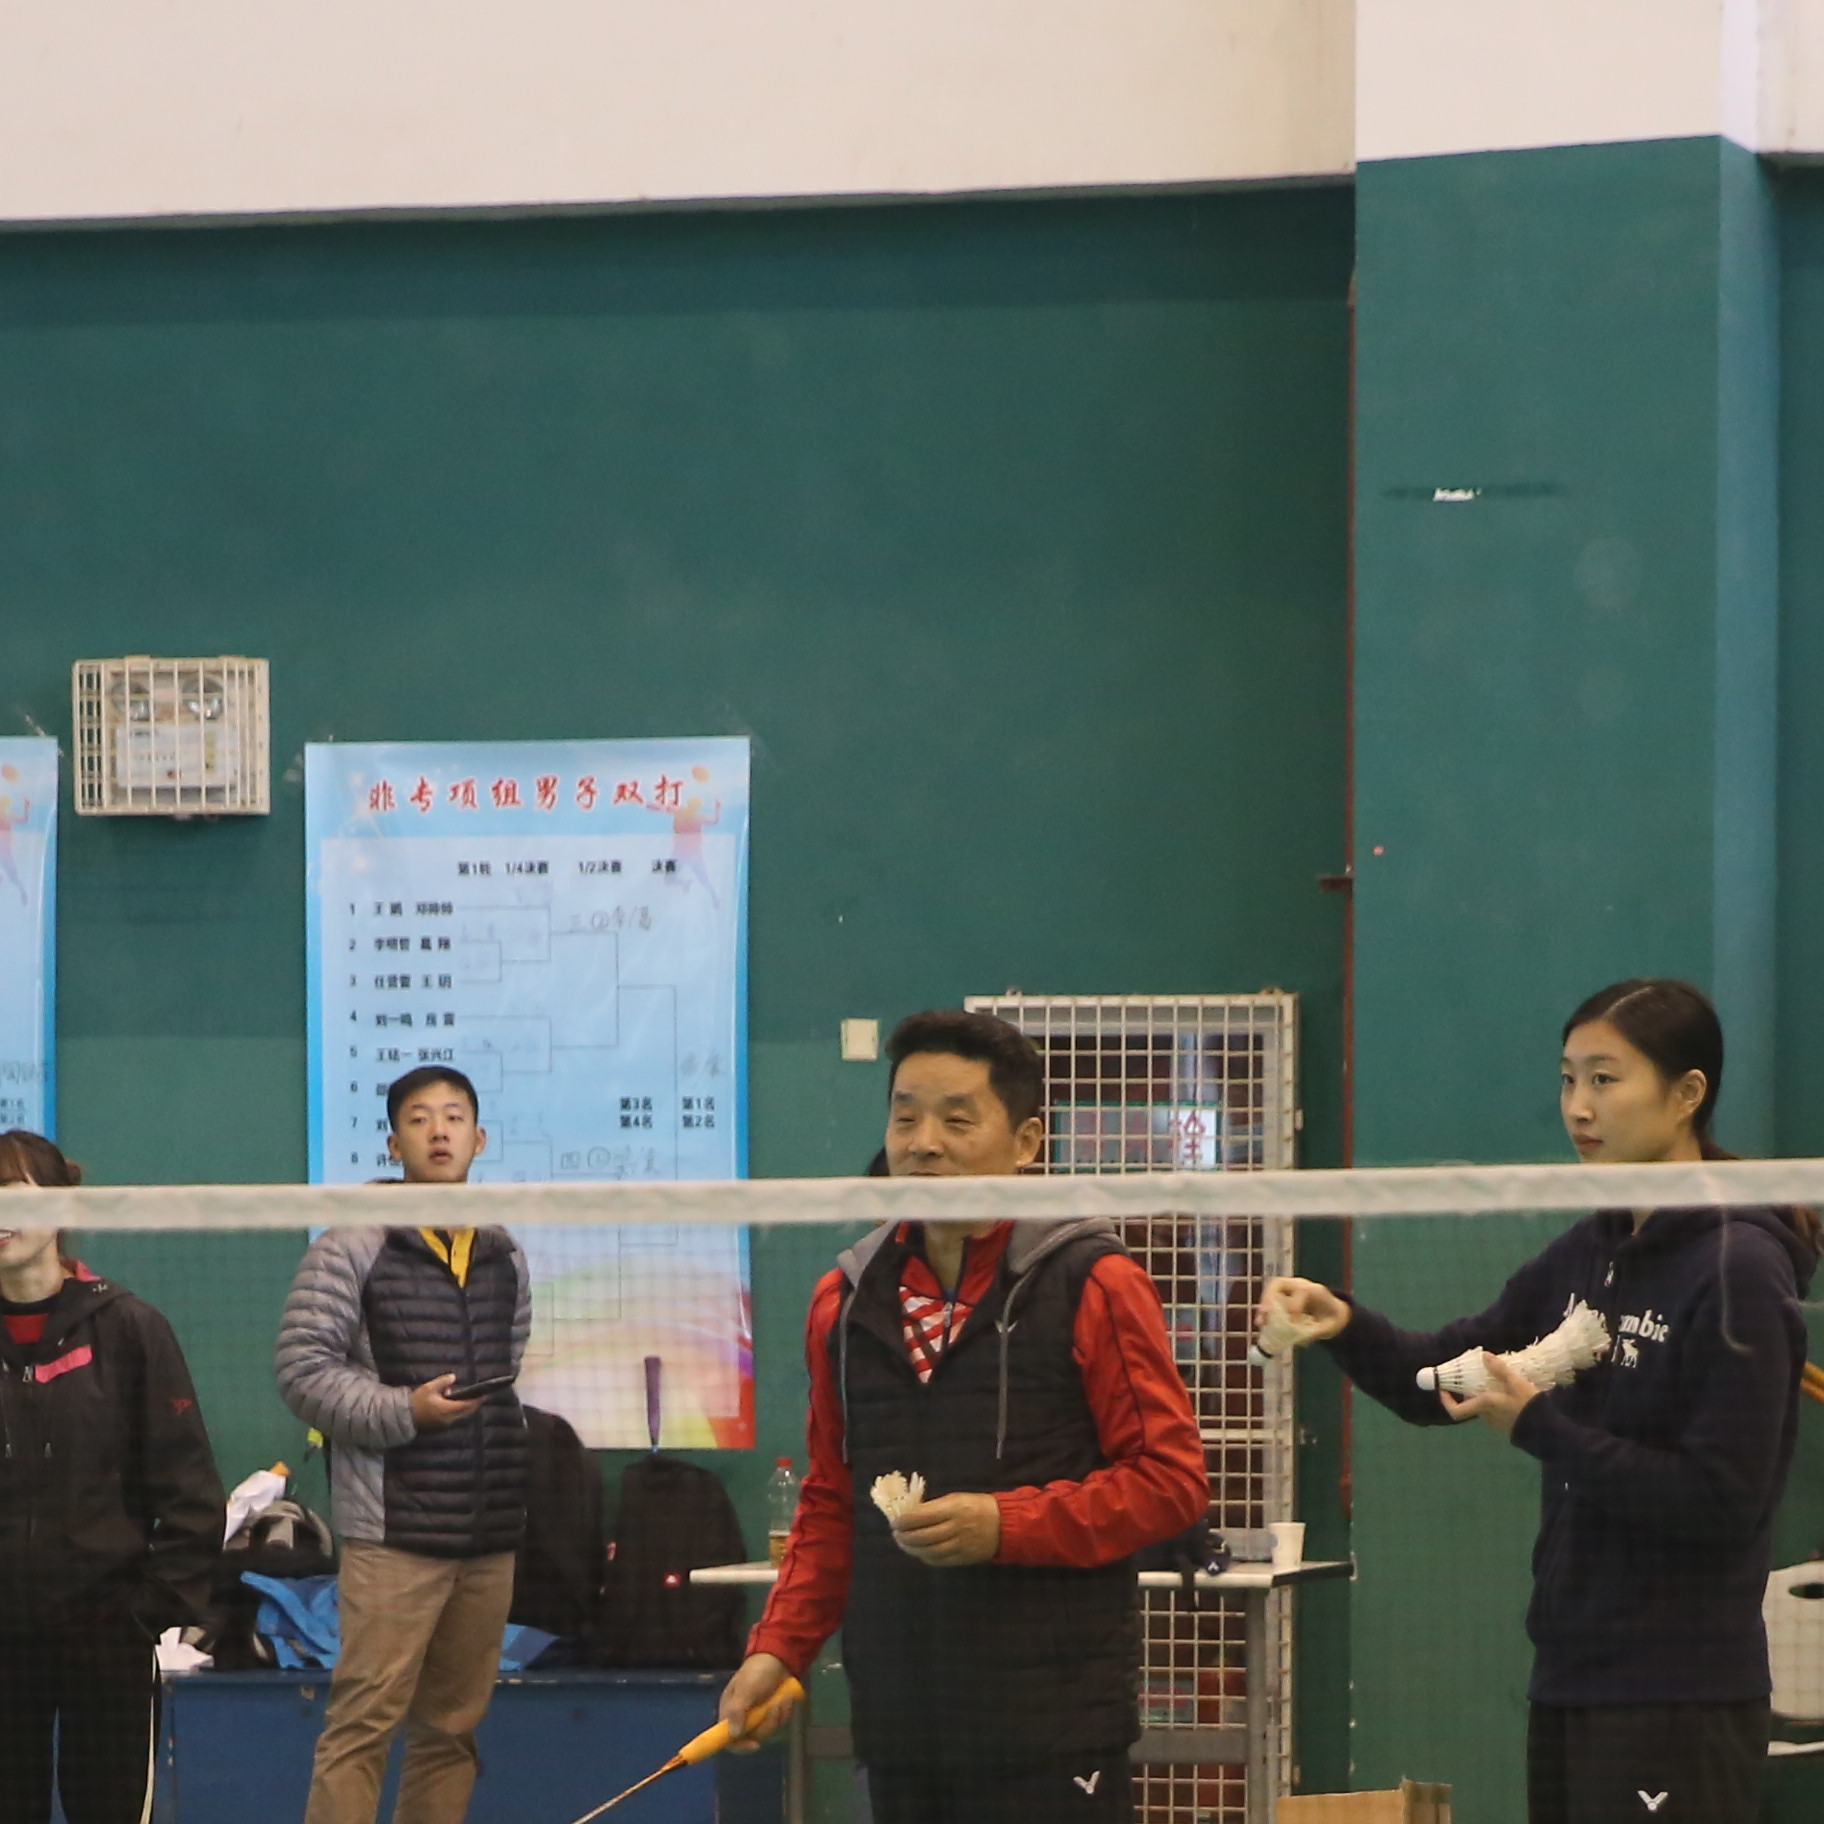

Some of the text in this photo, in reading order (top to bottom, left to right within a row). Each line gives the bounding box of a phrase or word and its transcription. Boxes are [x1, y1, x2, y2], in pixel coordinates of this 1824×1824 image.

[369, 774, 683, 812] 非专项组男子双打
[505, 860, 549, 875] 1/4决赛
[579, 860, 623, 875] 1/2决赛
[652, 859, 677, 873] 决赛
[350, 1010, 357, 1022] 4
[620, 1096, 715, 1111] 第3名 第1名
[620, 1114, 715, 1129] 第4名 第2名
